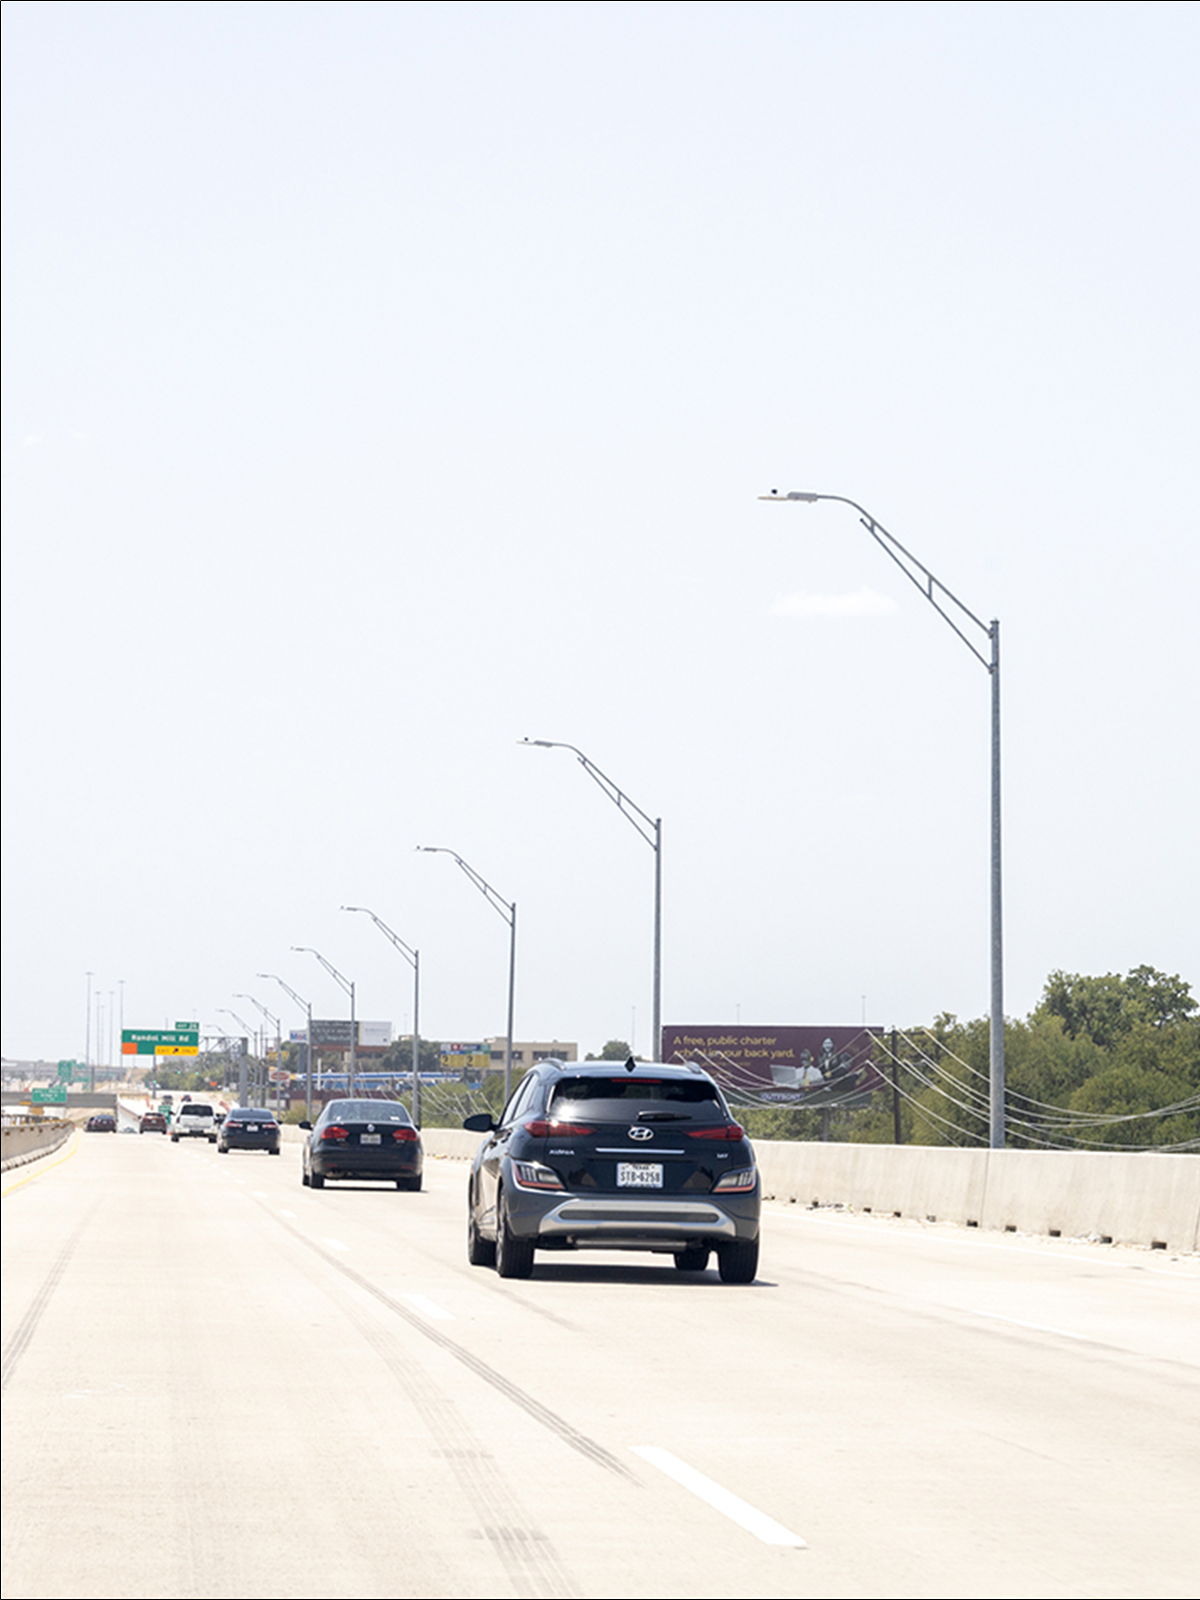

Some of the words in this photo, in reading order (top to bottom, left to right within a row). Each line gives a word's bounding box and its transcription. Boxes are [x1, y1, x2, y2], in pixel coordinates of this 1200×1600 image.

[131, 1034, 159, 1042] Randol
[673, 1036, 682, 1045] A
[683, 1035, 706, 1047] free,
[707, 1035, 738, 1047] public
[740, 1036, 777, 1046] charter
[744, 1048, 768, 1058] back
[770, 1048, 795, 1060] yard.
